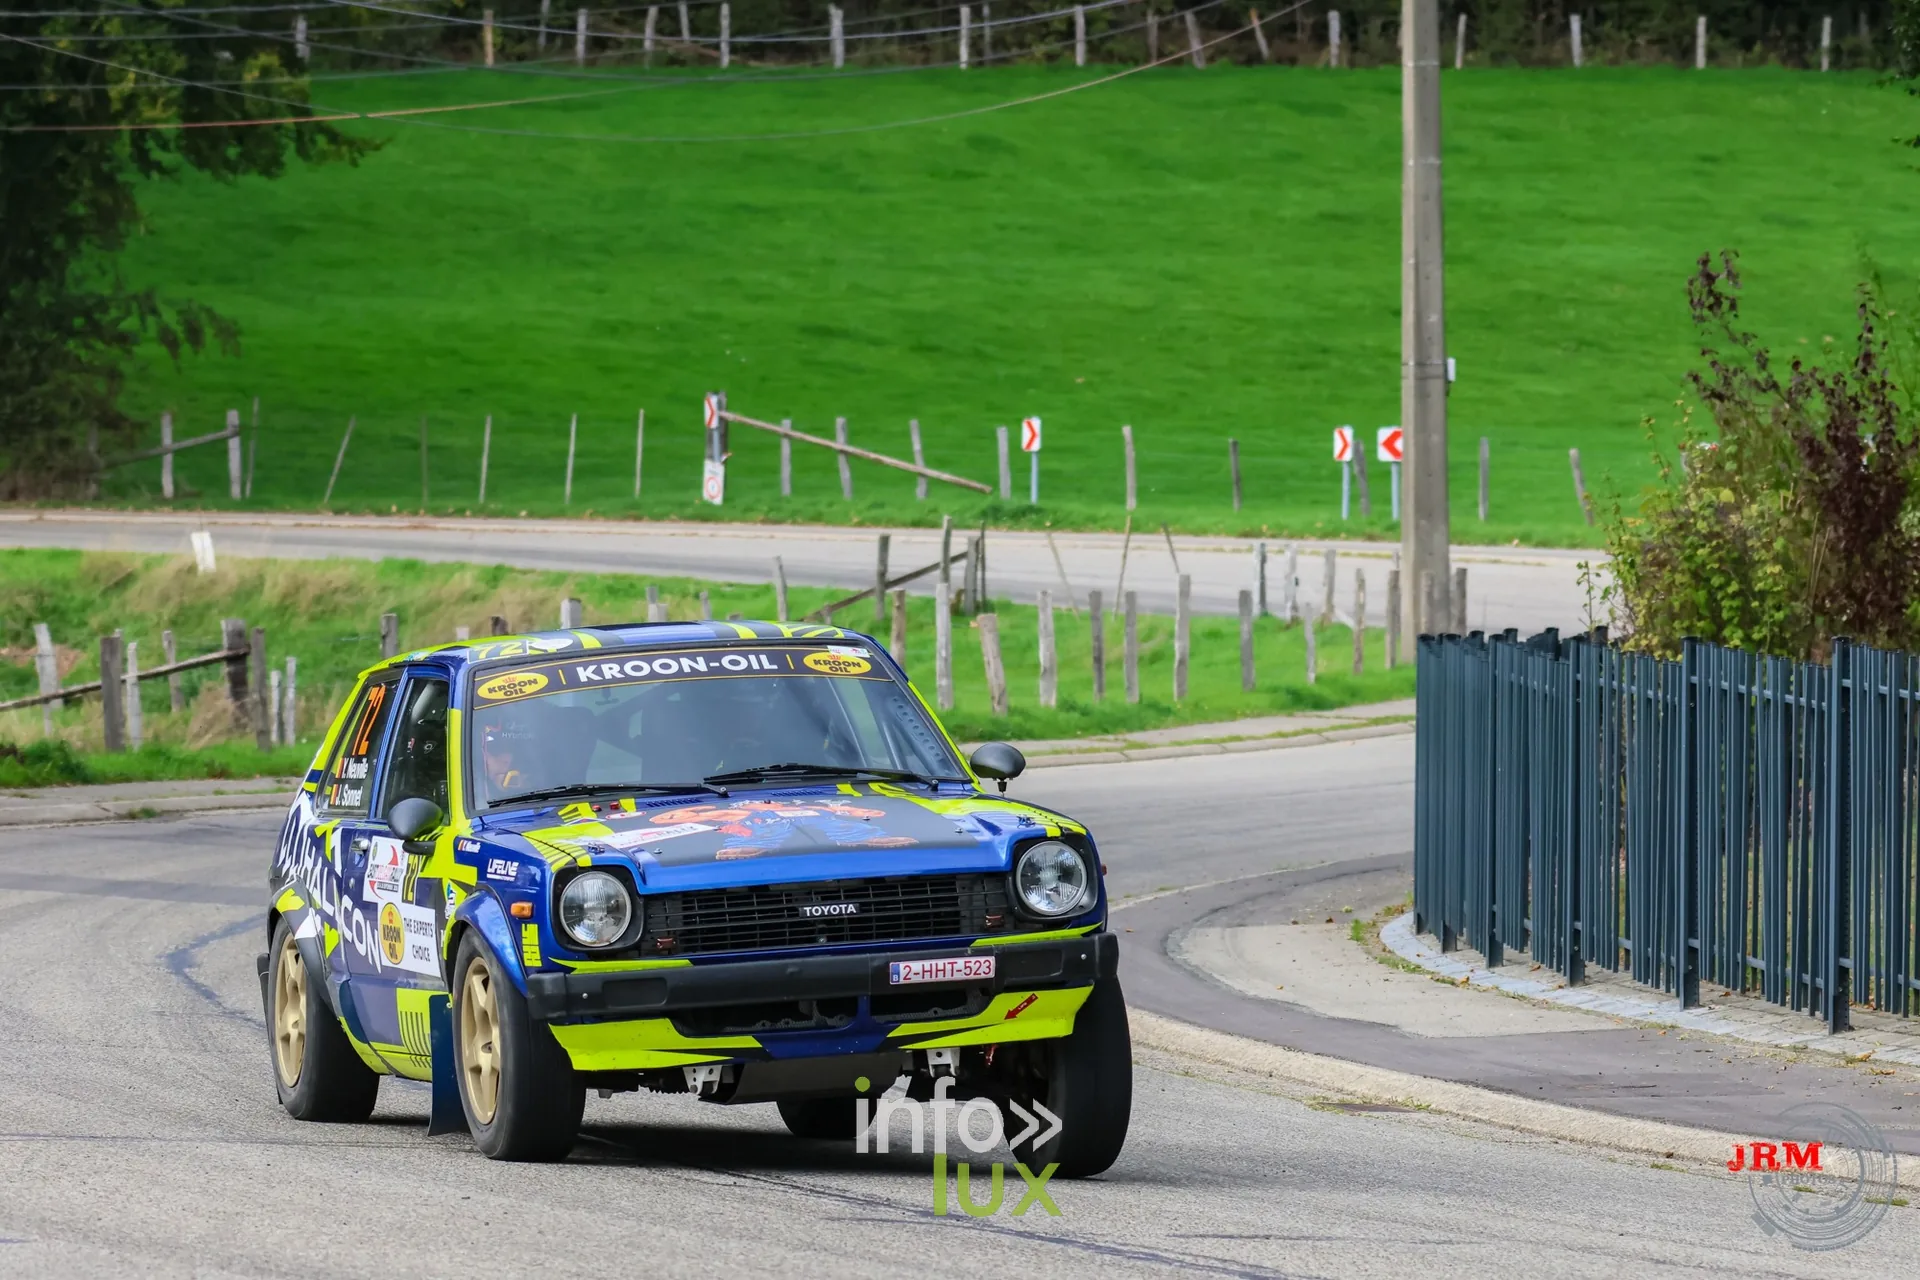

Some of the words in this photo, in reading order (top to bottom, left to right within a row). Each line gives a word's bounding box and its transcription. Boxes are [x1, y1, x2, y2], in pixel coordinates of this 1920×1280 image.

[473, 641, 524, 659] 72
[576, 654, 778, 683] KROON-OIL
[813, 659, 862, 668] KROON
[487, 678, 539, 694] KROON
[503, 688, 526, 697] OIL
[352, 685, 386, 756] 72
[403, 854, 420, 901] 72
[804, 903, 856, 917] TOYOTA
[382, 924, 401, 943] KROON
[403, 917, 412, 933] THE
[388, 942, 398, 960] OIL
[412, 944, 431, 962] CHOICE
[892, 974, 899, 982] B
[903, 959, 992, 981] 2-HHT-523
